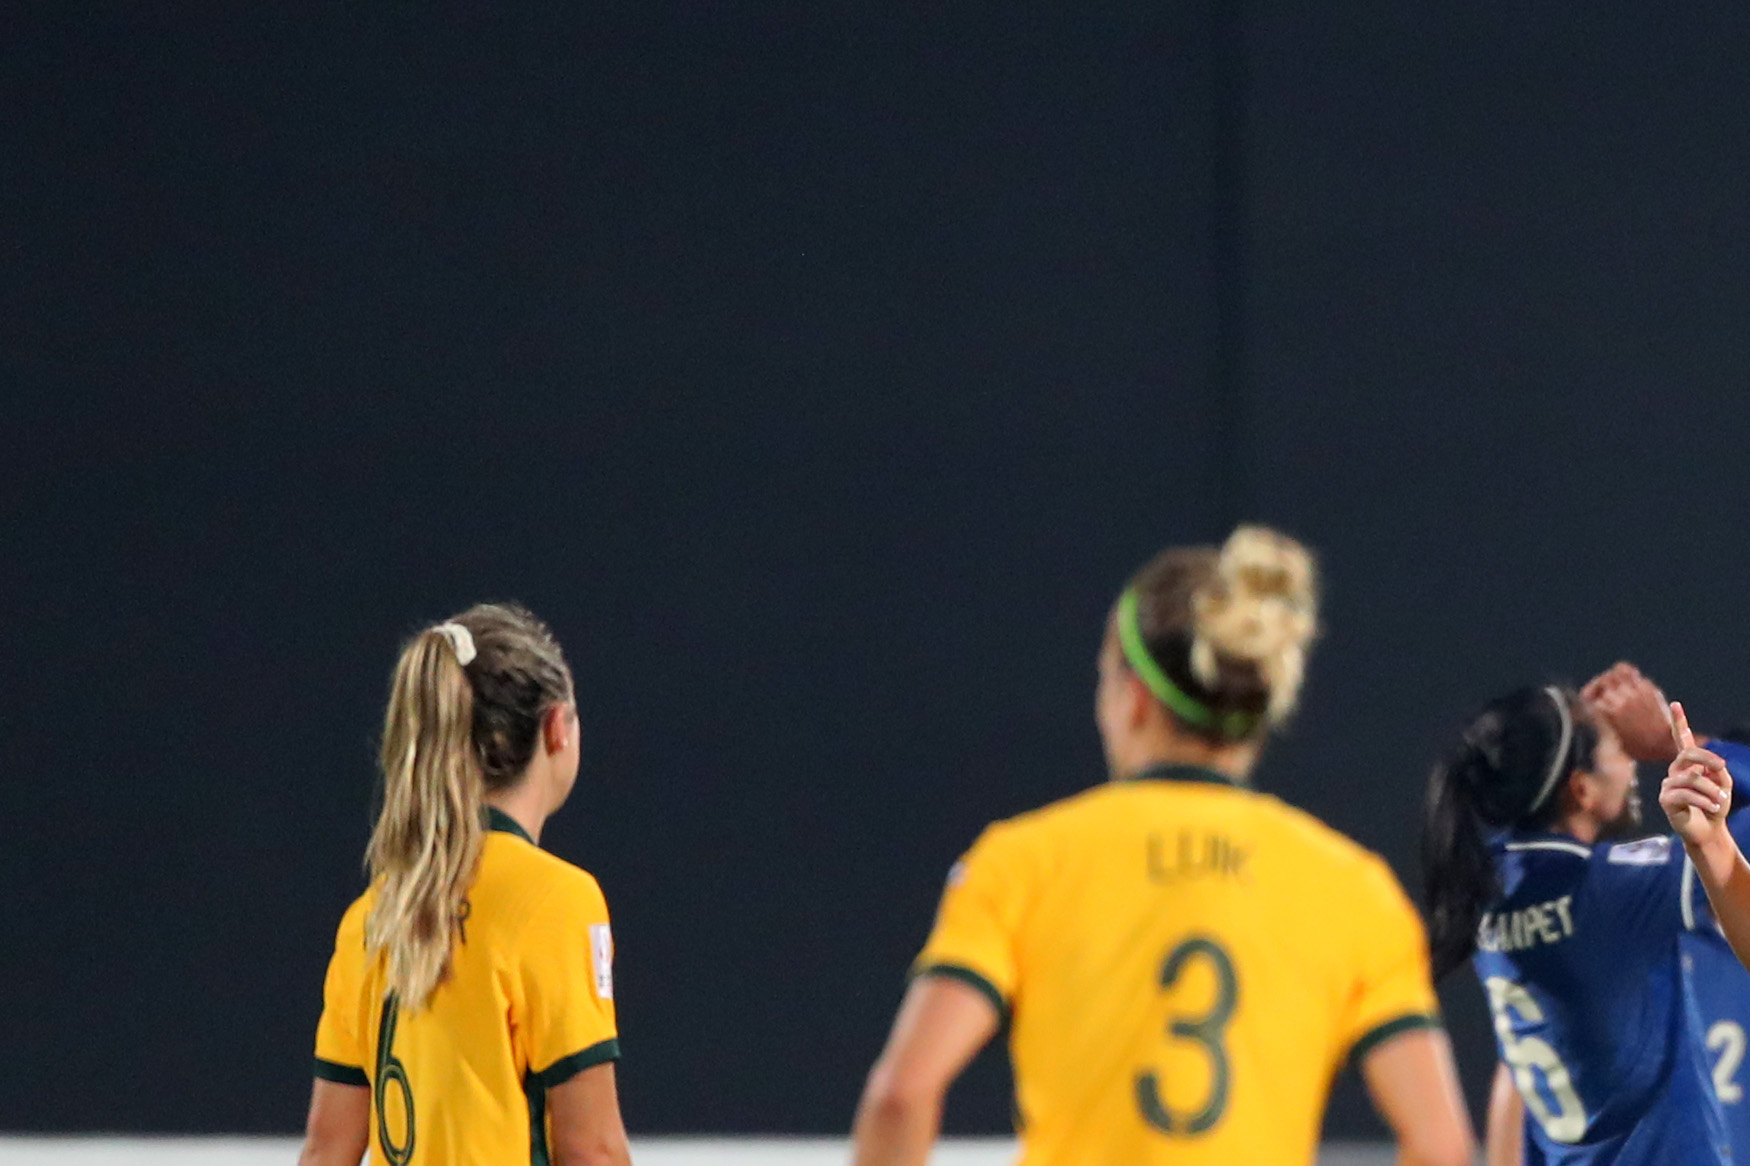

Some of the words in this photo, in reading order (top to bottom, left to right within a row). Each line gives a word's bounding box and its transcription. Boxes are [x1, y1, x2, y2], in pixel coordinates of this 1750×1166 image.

[1134, 936, 1240, 1138] 3
[1485, 976, 1587, 1144] 6
[1706, 1019, 1746, 1104] 2
